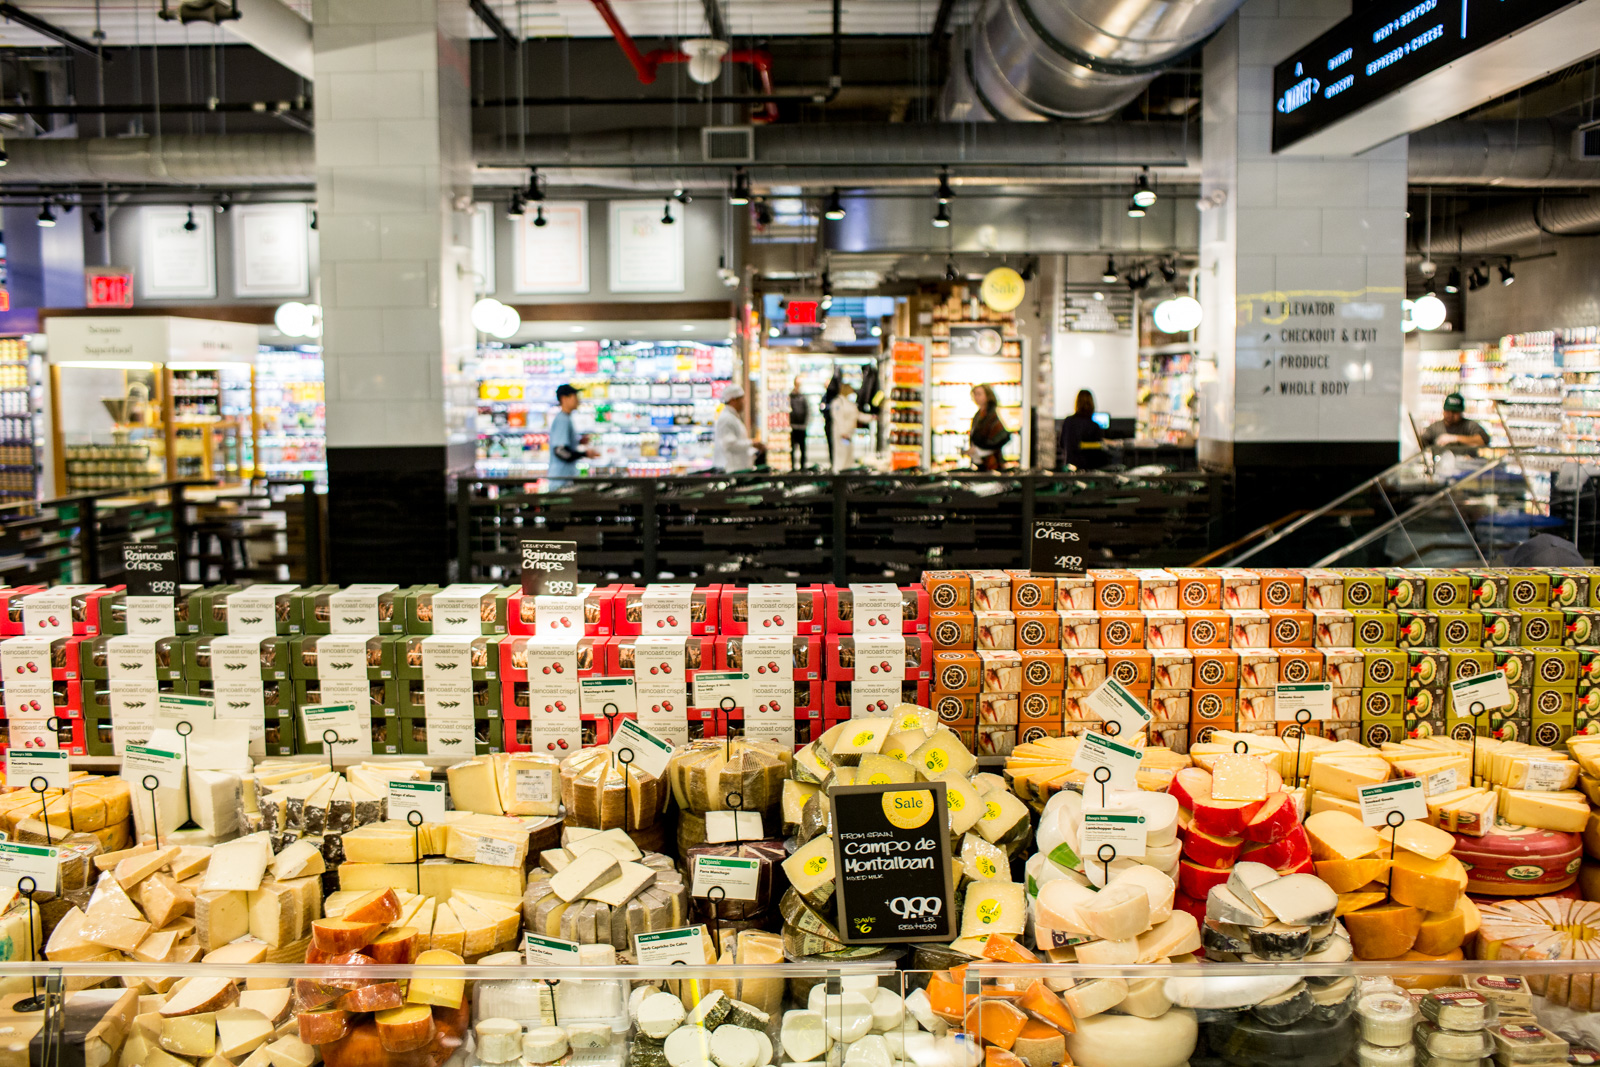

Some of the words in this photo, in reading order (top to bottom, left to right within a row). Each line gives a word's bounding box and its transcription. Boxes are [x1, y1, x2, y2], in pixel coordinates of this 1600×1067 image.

[1373, 22, 1393, 43] MEAT
[1399, 0, 1438, 27] SEAFOOD
[1366, 47, 1403, 76] ESPRESSO
[1410, 24, 1444, 51] CHEESE
[1328, 48, 1353, 71] BAKERY
[1324, 74, 1354, 99] GROCERY
[1285, 77, 1312, 113] MARKET
[990, 281, 1018, 294] Sale
[1281, 302, 1335, 316] ELEVATOR
[1281, 329, 1335, 343] CHECKOUT
[1342, 329, 1349, 343] &
[1354, 329, 1377, 343] EXIT
[1280, 354, 1330, 369] PRODUCE
[1280, 382, 1315, 395] WHOLE
[1322, 382, 1350, 395] BODY
[1035, 527, 1080, 543] Crisps
[124, 550, 175, 561] Raincoast
[522, 549, 576, 562] Raincoast
[125, 560, 163, 571] Crisps
[522, 559, 565, 572] Crisps
[126, 745, 147, 753] Organic
[929, 751, 944, 769] Sale
[894, 797, 923, 809] Sale
[840, 832, 865, 840] FROM
[844, 841, 911, 855] Campo
[914, 837, 936, 850] de
[699, 858, 721, 867] Organic
[809, 860, 822, 872] Sale
[845, 856, 934, 873] Montalban
[1476, 873, 1505, 882] Originale
[854, 916, 876, 924] SAVE
